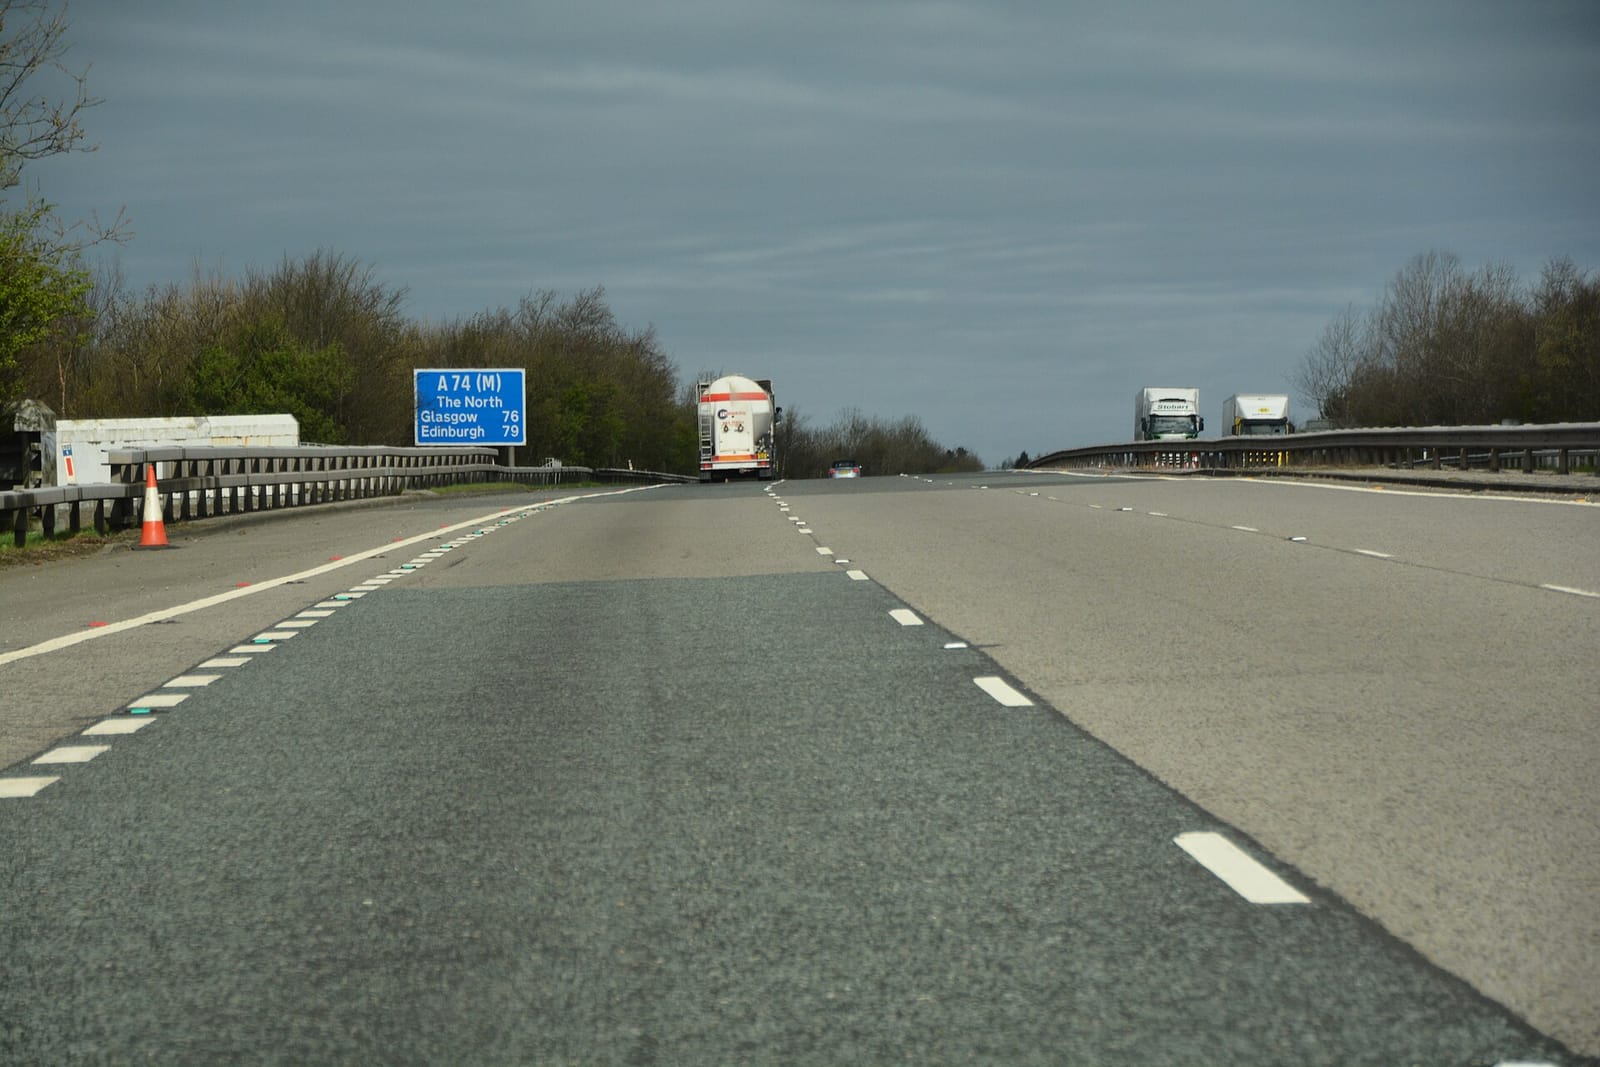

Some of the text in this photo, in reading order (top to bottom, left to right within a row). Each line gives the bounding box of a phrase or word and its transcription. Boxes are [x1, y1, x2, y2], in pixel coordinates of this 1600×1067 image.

[437, 396, 503, 408] The North
[420, 410, 519, 425] Glasgow 76
[421, 425, 519, 439] Edinburgh 79
